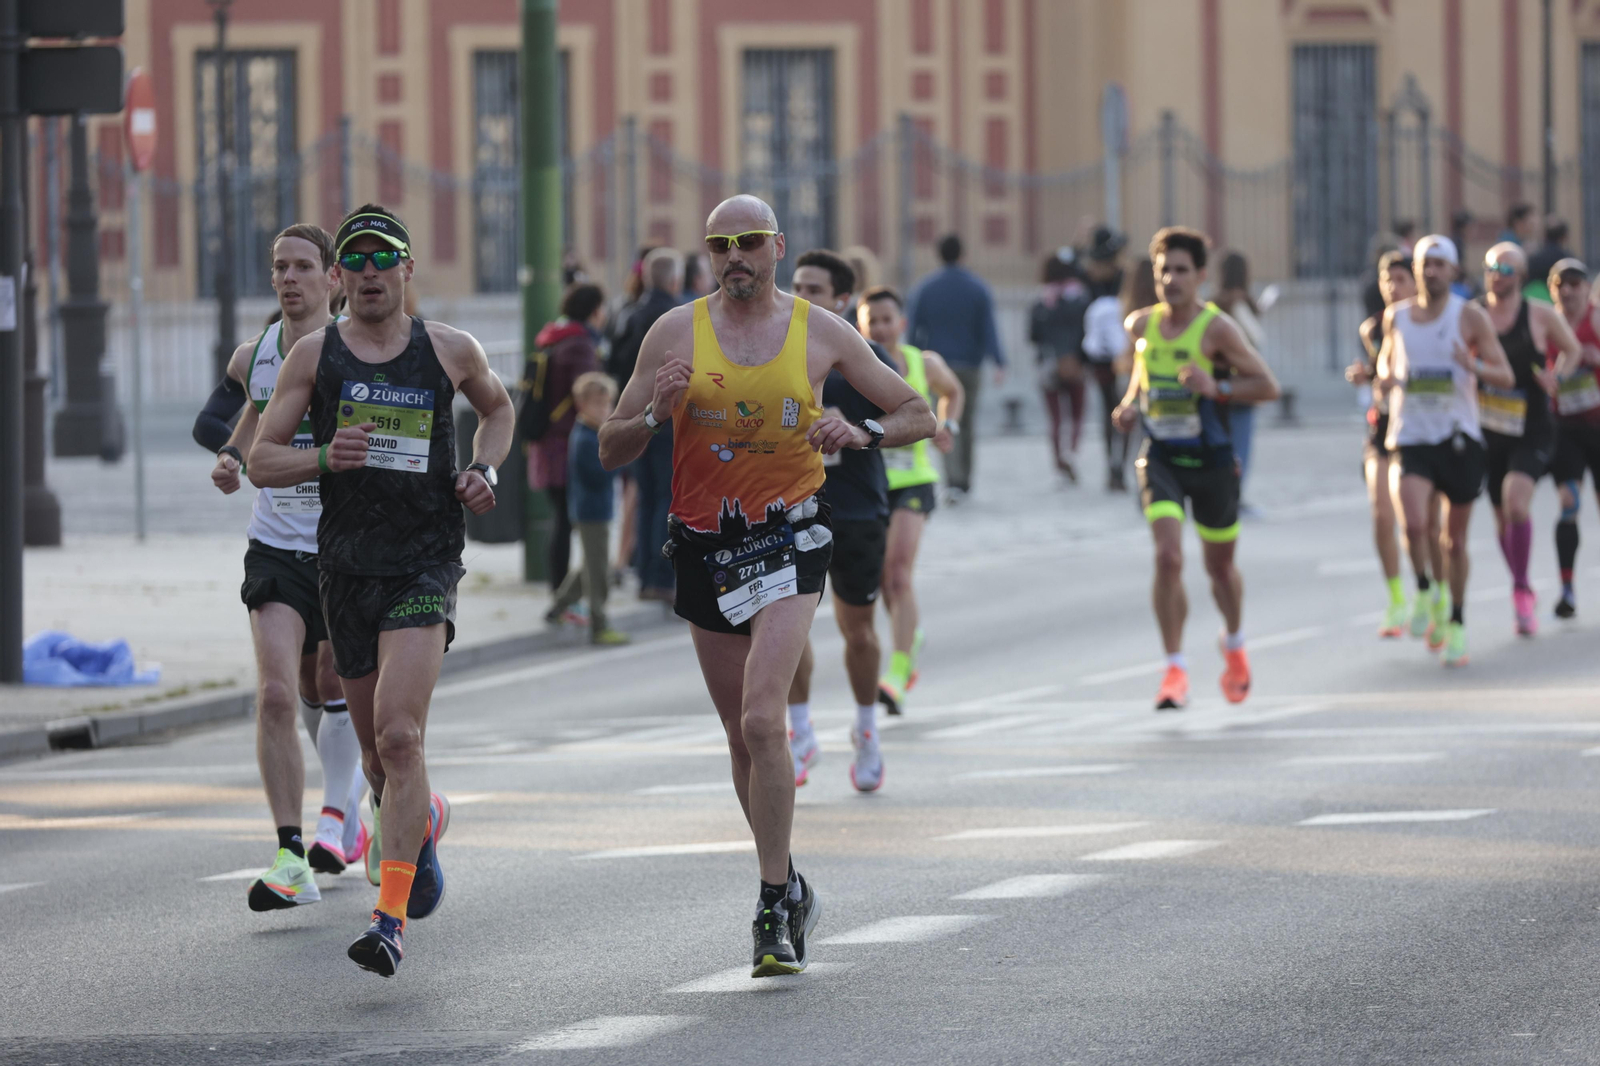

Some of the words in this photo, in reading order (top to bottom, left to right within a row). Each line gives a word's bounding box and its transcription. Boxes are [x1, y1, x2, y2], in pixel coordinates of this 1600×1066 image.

[370, 220, 388, 230] MAX
[370, 415, 401, 430] 1519
[368, 437, 397, 449] DAVID
[296, 485, 320, 494] CHRIS
[748, 580, 763, 595] FER
